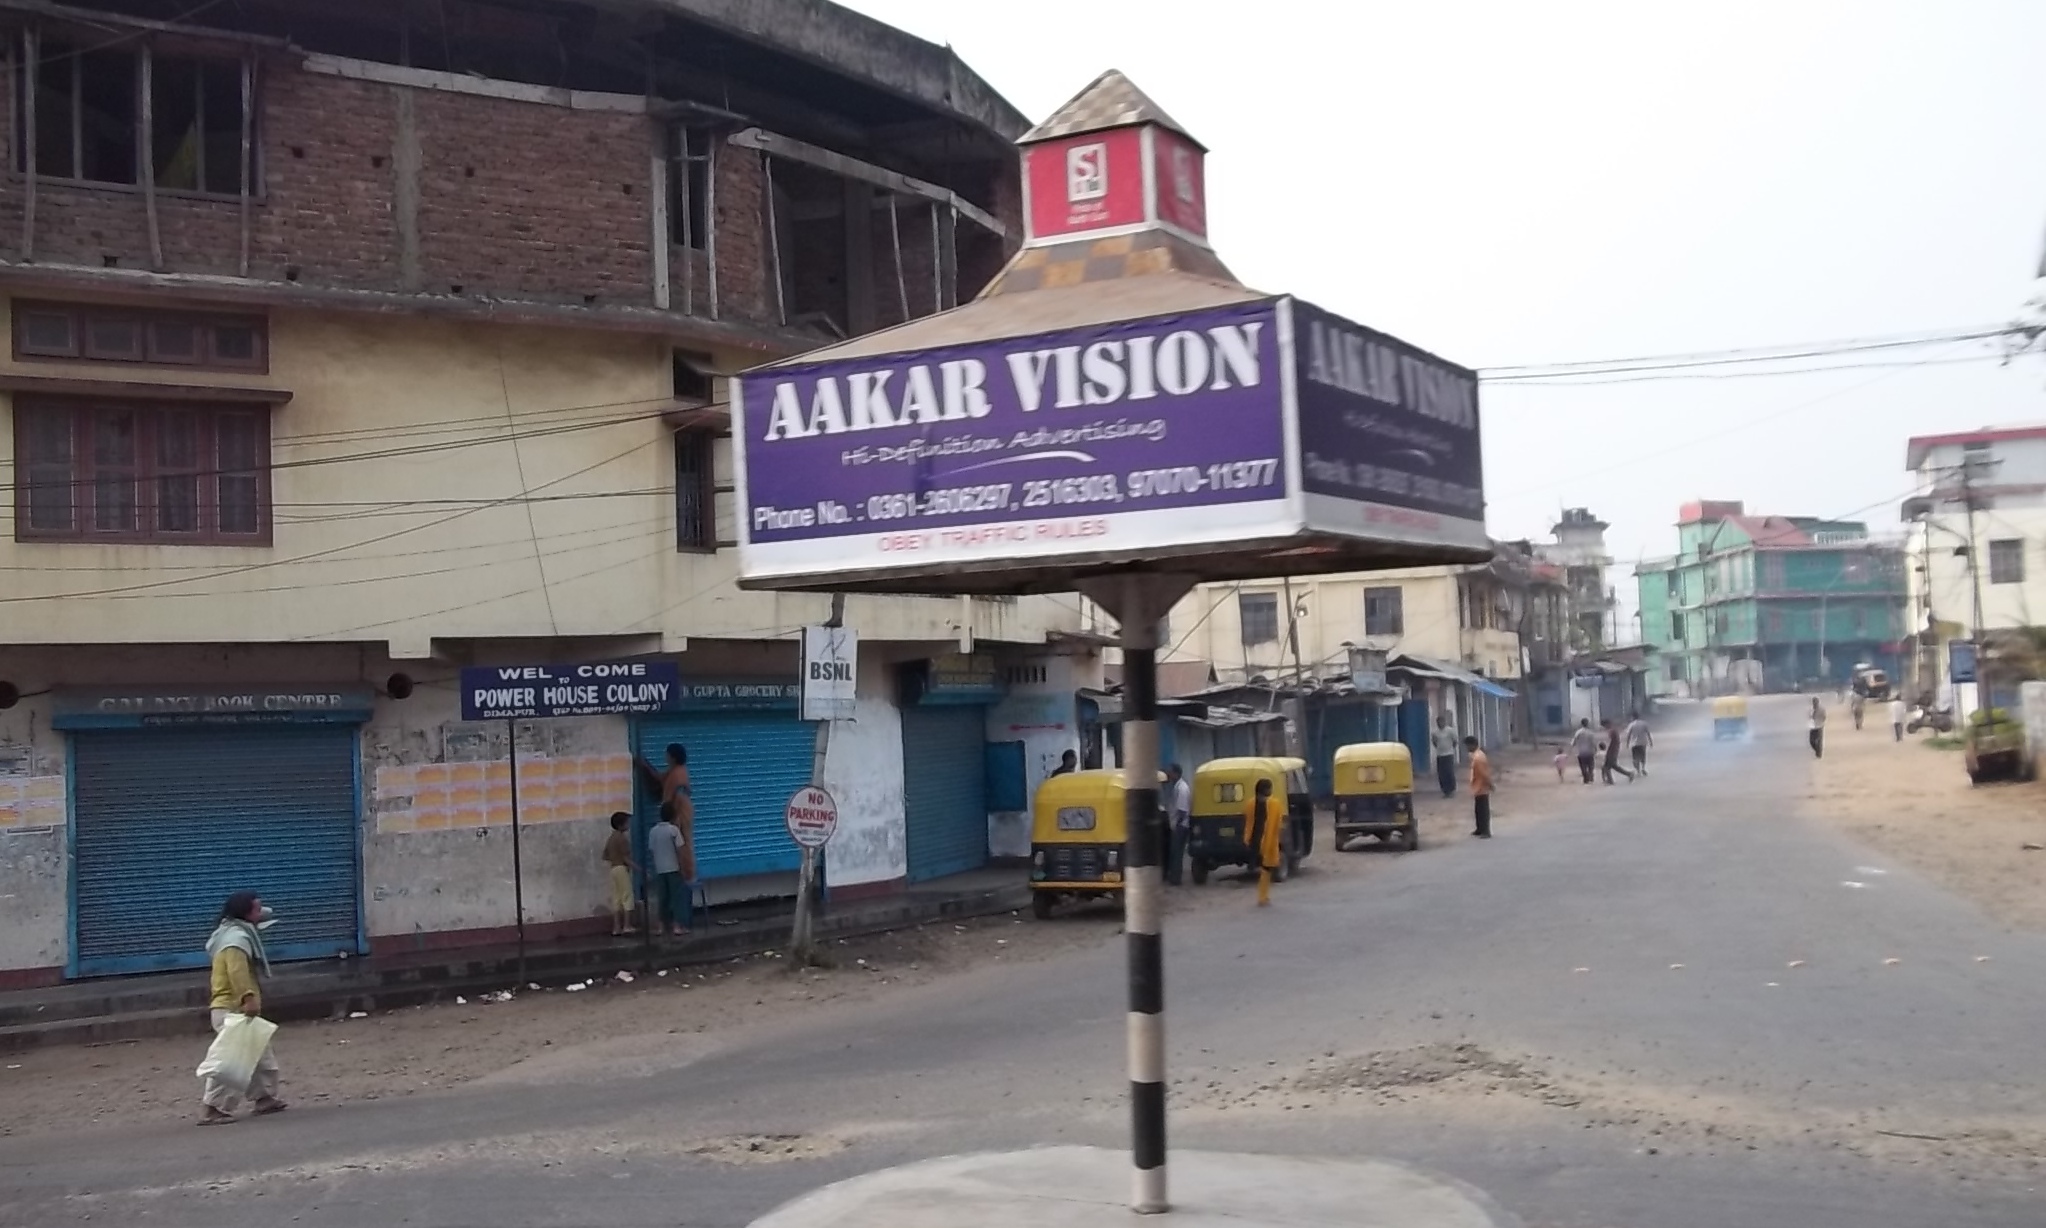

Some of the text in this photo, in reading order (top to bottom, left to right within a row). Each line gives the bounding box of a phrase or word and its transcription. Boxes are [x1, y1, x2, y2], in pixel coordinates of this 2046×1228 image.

[763, 322, 1264, 441] AAKAR VISION
[841, 418, 1167, 465] Hi-Definition Advertising
[754, 506, 815, 530] Phone
[879, 517, 1109, 552] OBEY TRAFFIC RULES
[577, 664, 647, 677] COME
[810, 661, 853, 681] BSNL
[474, 683, 670, 708] POWER HOUSE COLONY
[693, 685, 731, 698] GUPTA
[734, 684, 783, 698] GROCERY
[263, 694, 342, 710] CENTRE
[808, 792, 824, 806] NO
[790, 806, 835, 822] PARKING
